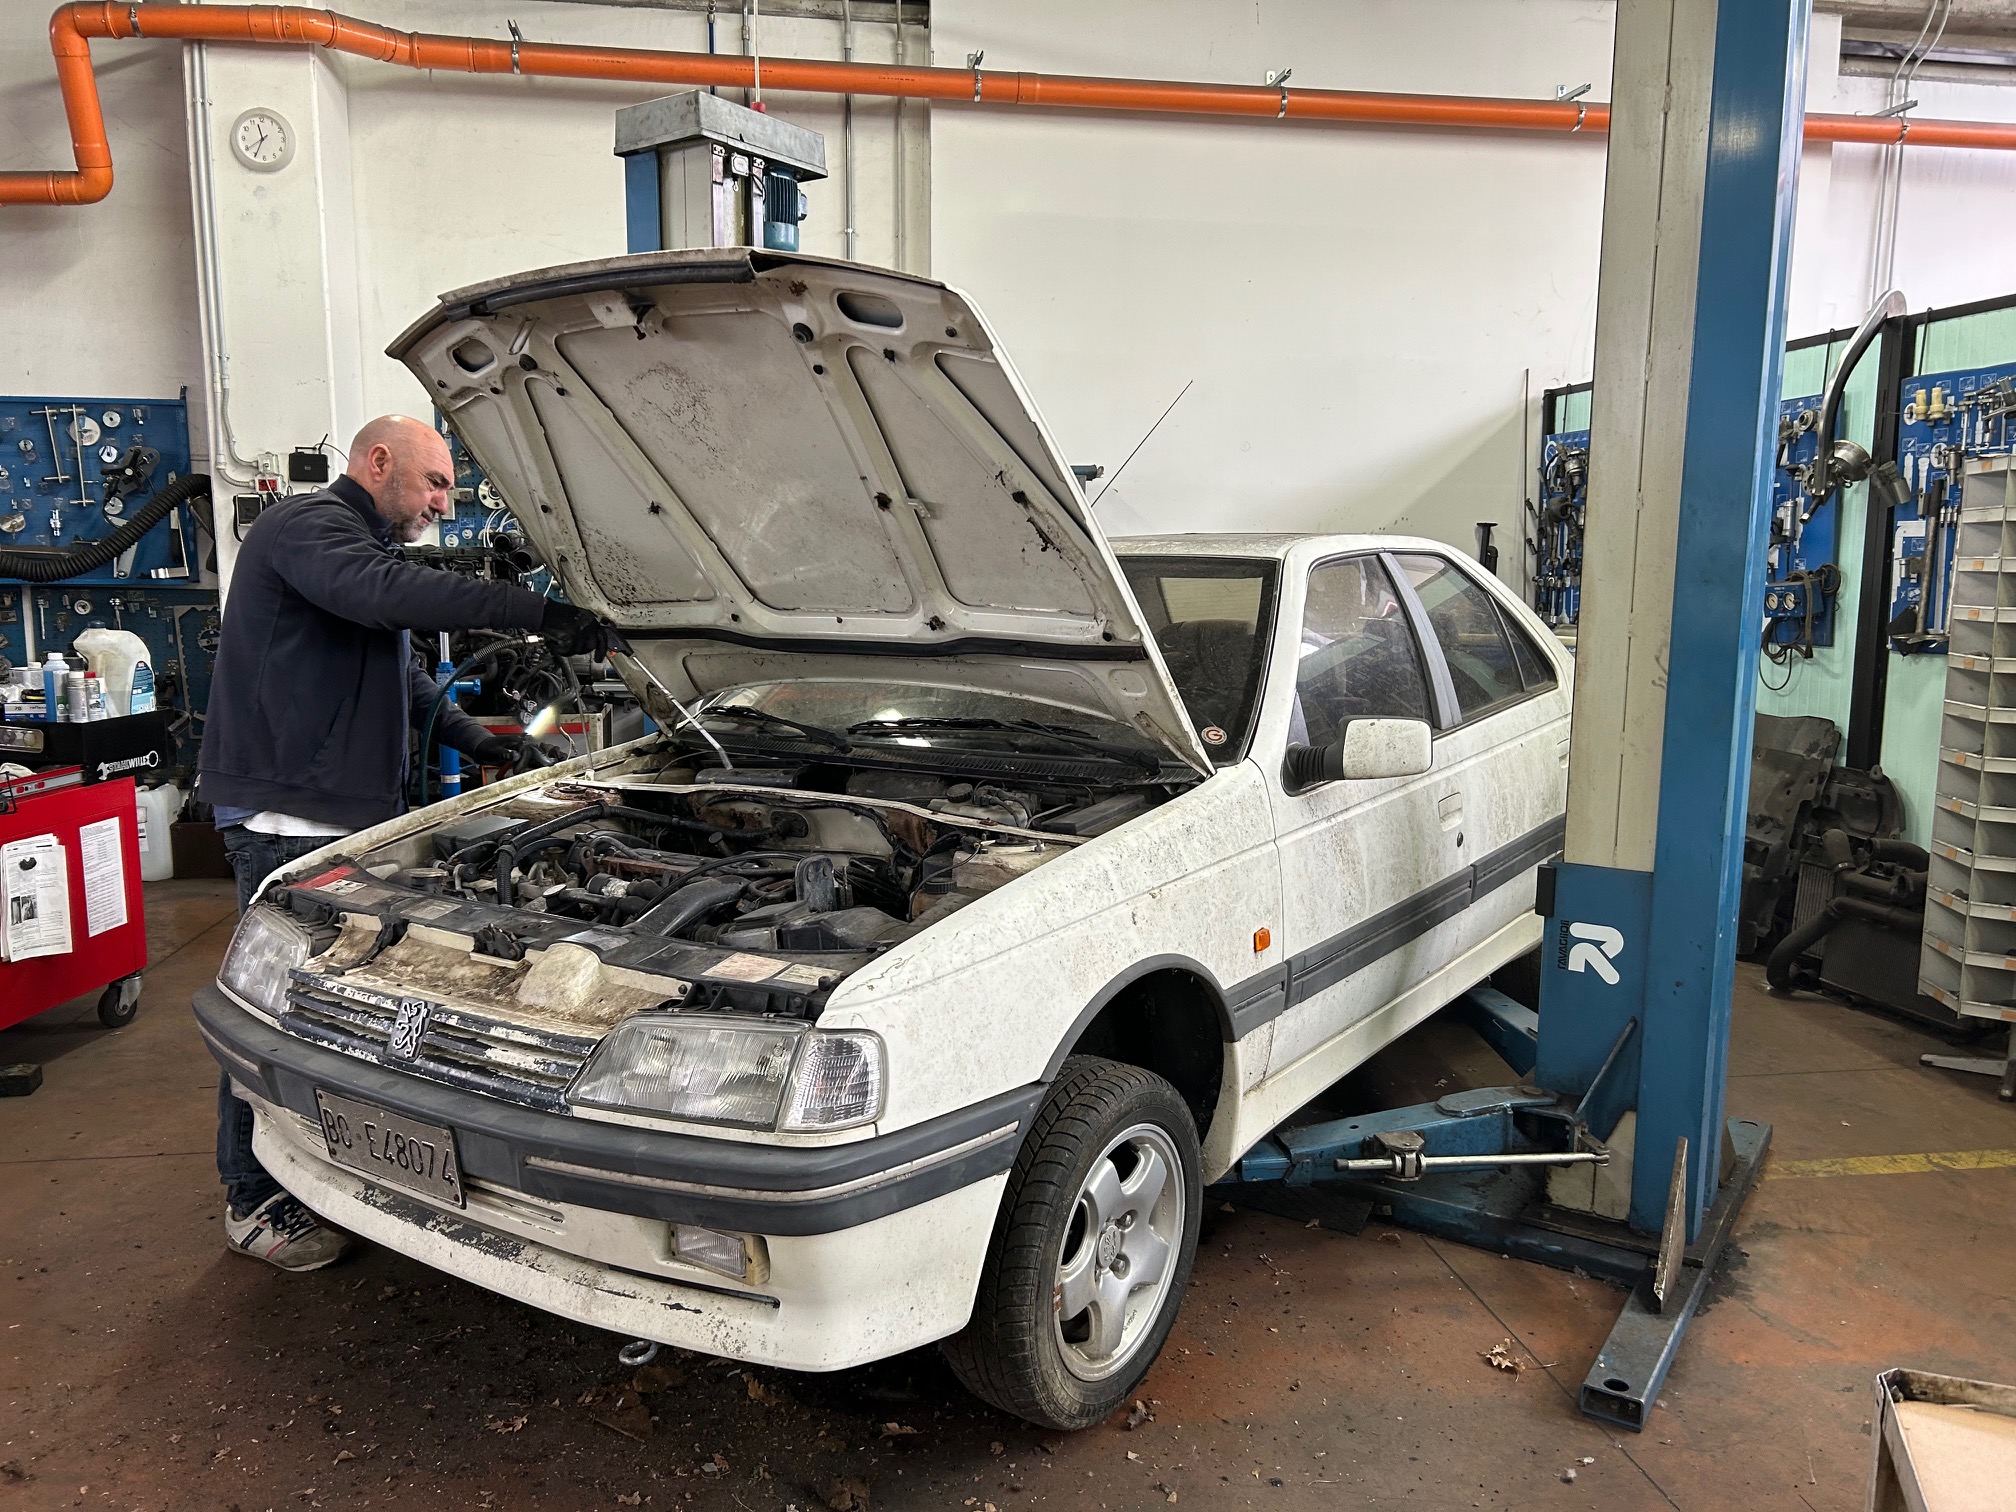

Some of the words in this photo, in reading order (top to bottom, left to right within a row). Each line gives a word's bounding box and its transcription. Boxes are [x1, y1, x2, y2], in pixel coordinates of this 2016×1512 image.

[108, 755, 148, 773] STAHLWILLE
[322, 1106, 352, 1149] BO
[364, 1121, 455, 1186] E48074
